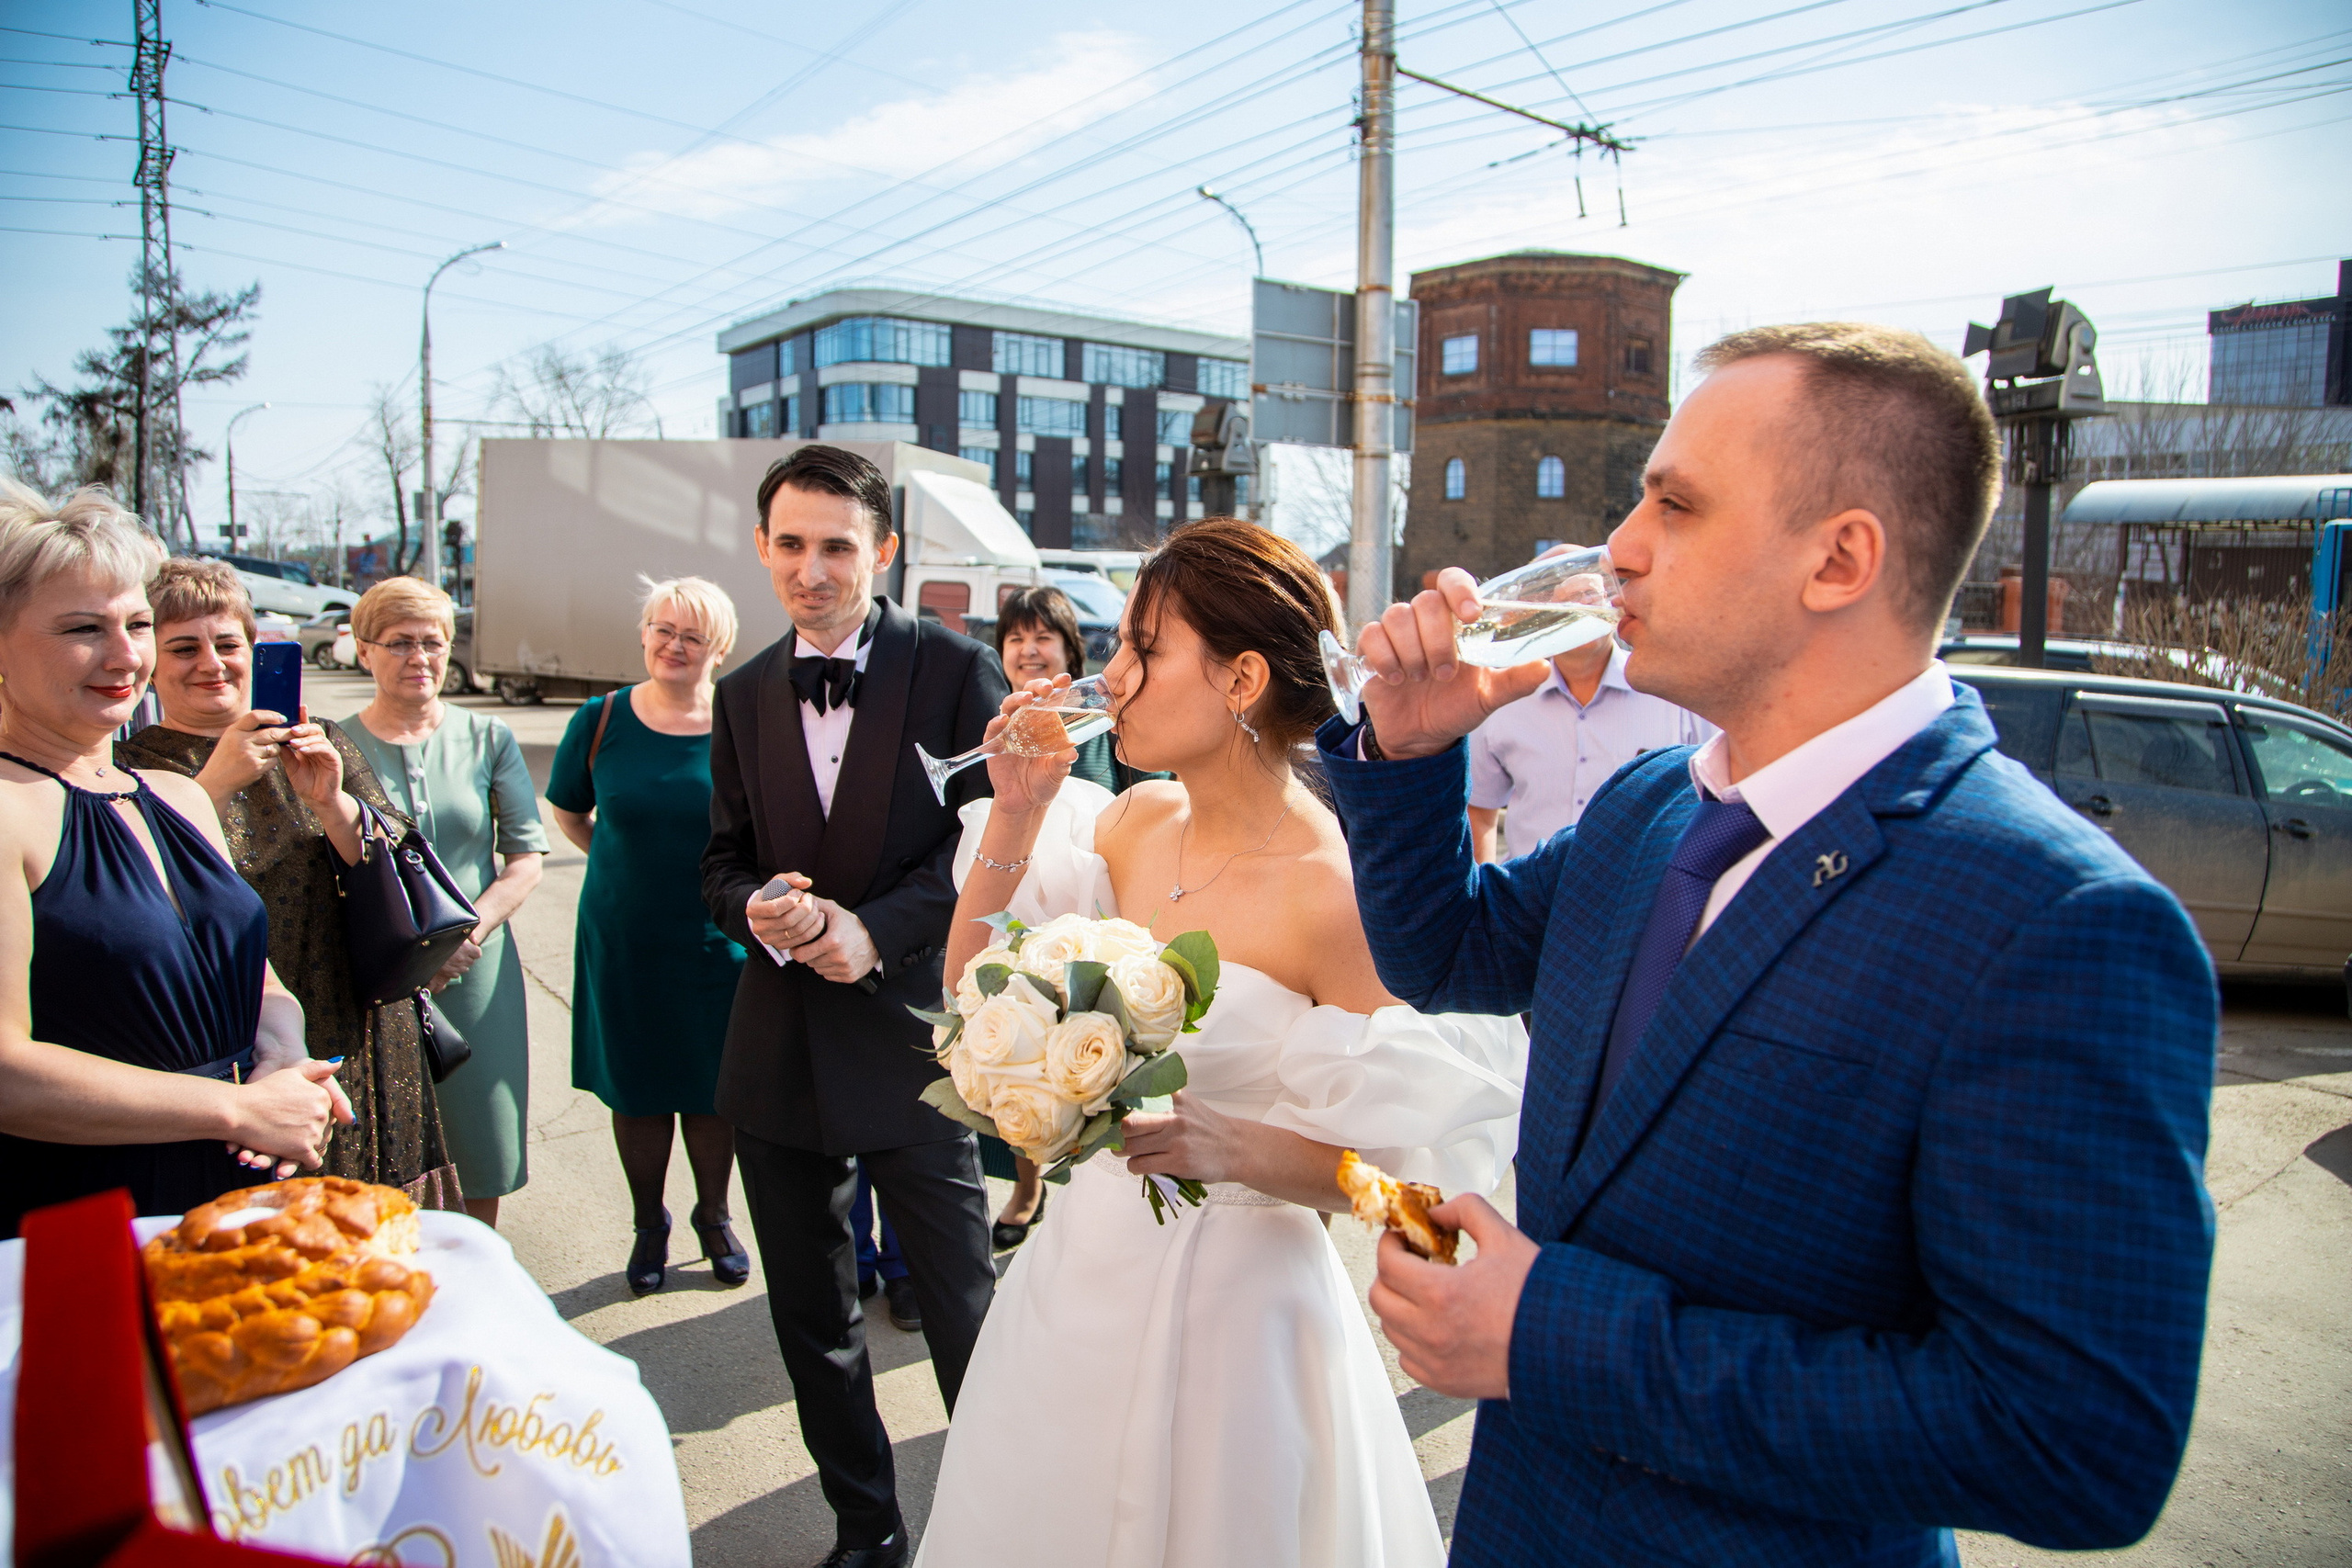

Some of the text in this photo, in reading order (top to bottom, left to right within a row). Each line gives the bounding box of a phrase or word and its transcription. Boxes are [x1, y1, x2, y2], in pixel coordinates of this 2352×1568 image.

[210, 1365, 623, 1544] овет да Любовь
